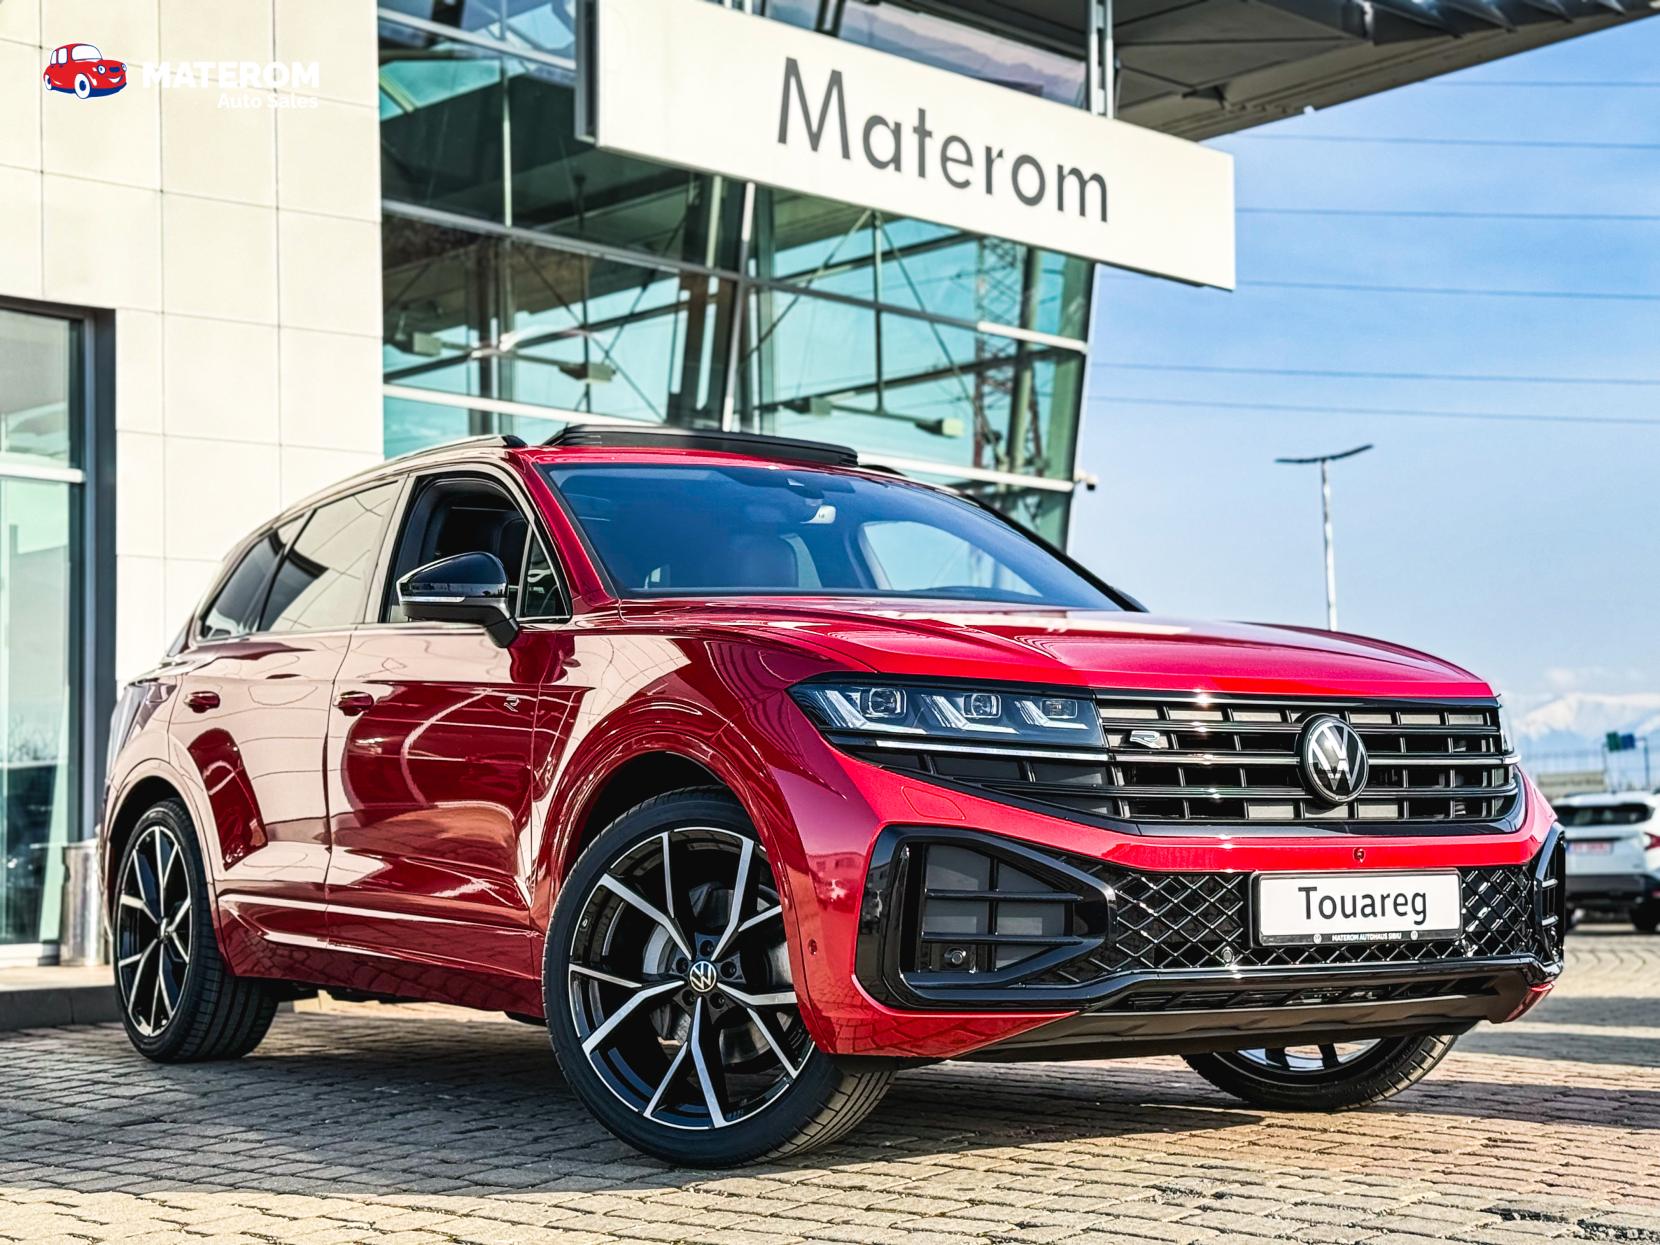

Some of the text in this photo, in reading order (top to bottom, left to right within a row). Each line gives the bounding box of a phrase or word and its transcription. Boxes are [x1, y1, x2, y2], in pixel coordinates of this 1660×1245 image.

[777, 56, 1108, 223] Materom
[1298, 886, 1427, 926] Touareg
[1331, 934, 1359, 942] MATEROM
[1359, 933, 1388, 941] AUTOHAUS
